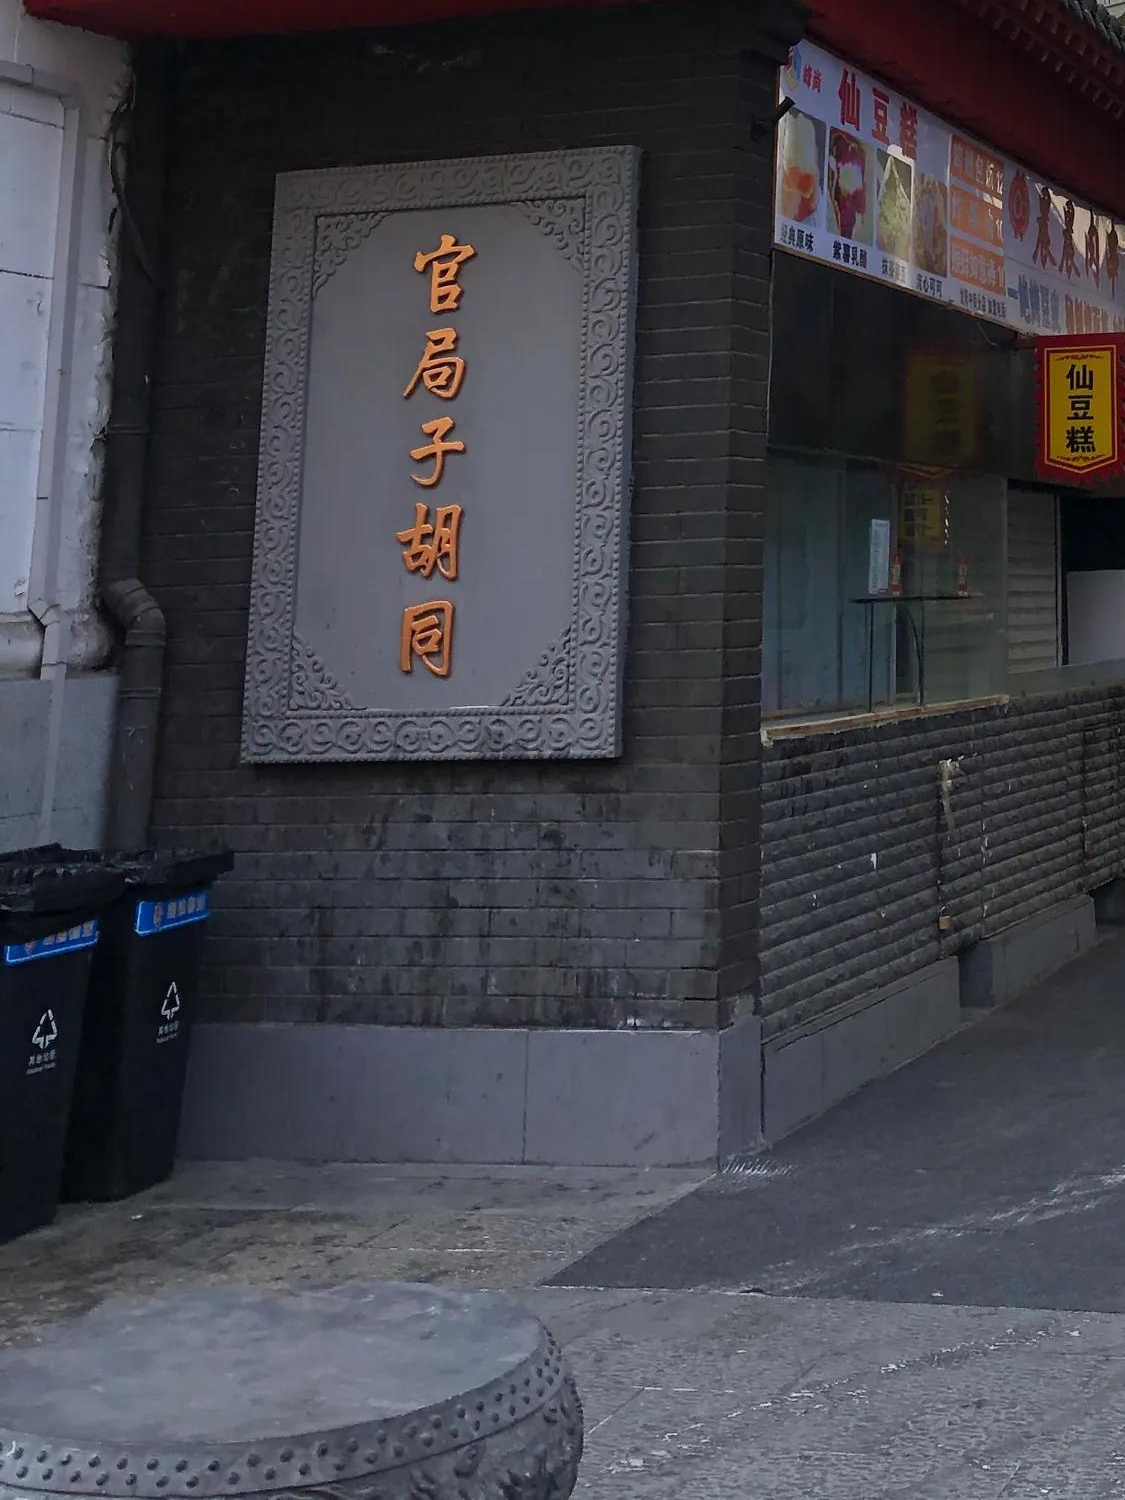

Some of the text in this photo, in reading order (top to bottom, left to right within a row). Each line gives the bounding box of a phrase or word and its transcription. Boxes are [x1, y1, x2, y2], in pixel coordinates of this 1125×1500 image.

[838, 68, 918, 160] 仙豆糕
[780, 223, 814, 252] 经典原味
[1065, 363, 1096, 453] 仙豆糕
[395, 234, 476, 677] 官局子胡同
